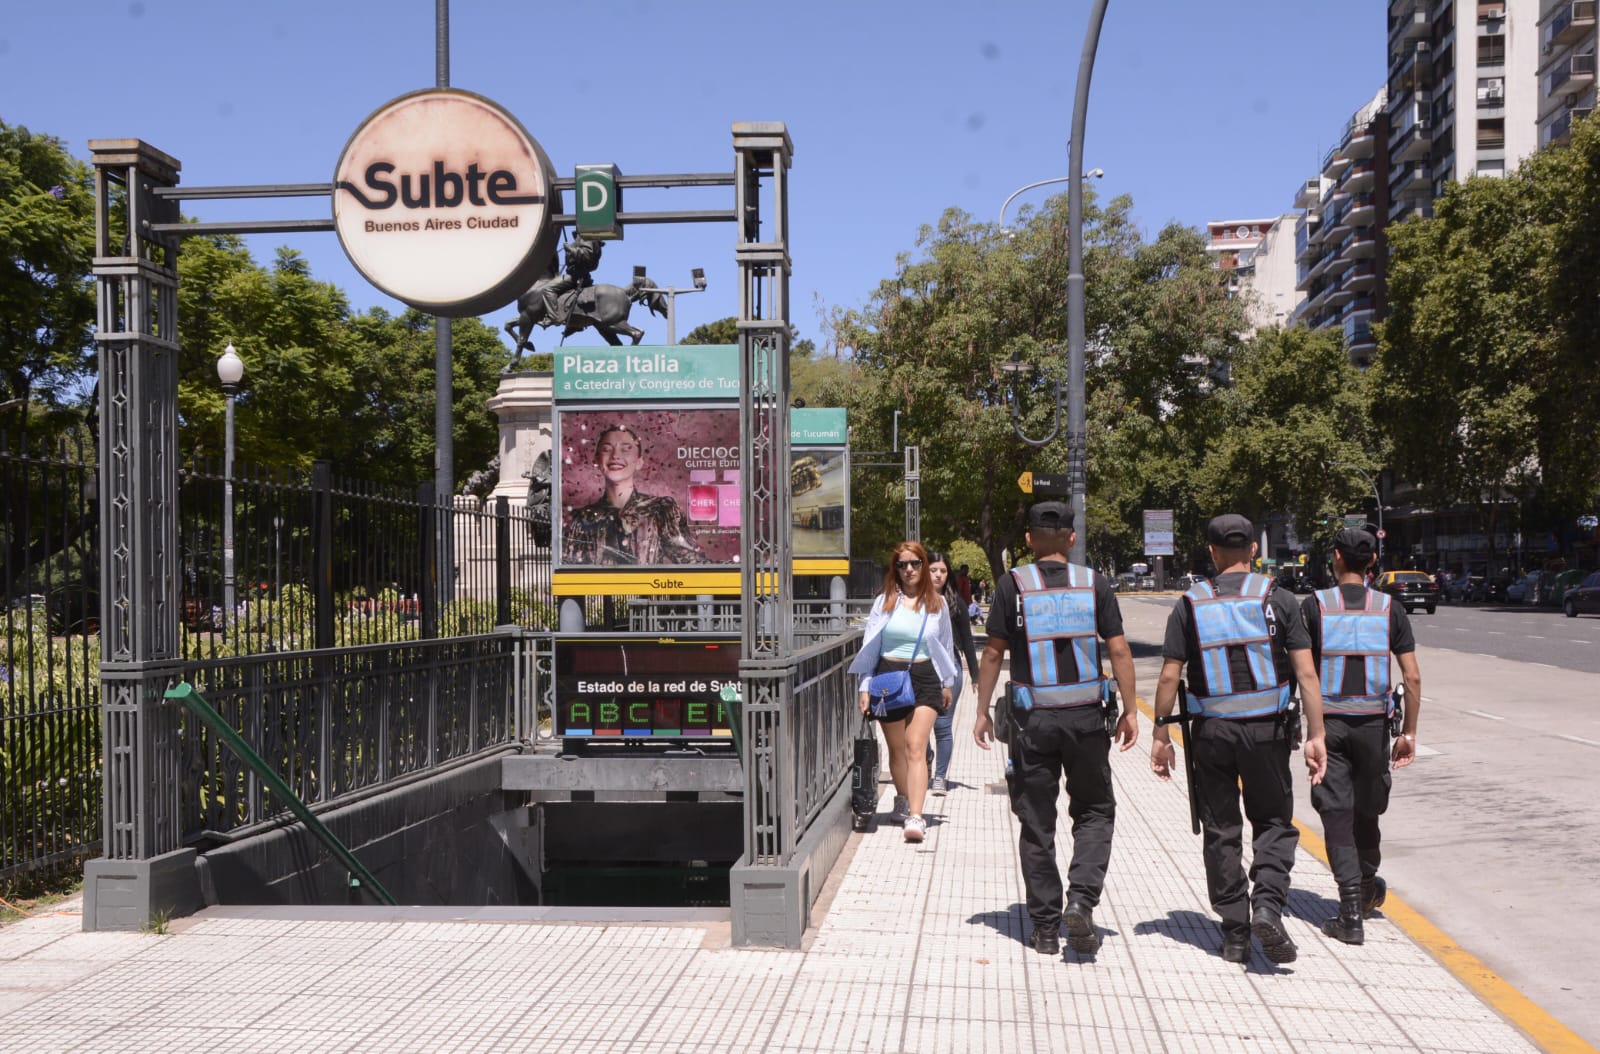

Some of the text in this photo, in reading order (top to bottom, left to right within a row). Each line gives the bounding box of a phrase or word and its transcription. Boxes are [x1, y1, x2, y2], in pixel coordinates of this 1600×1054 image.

[356, 161, 540, 209] Subte
[582, 181, 608, 212] D
[364, 216, 519, 233] Buenos Aires Ciudad
[563, 354, 679, 374] Plaza Italia
[564, 382, 571, 390] a
[574, 379, 625, 390] Catedral
[629, 381, 637, 392] y
[639, 378, 695, 392] Congreso
[698, 378, 714, 388] de
[677, 447, 740, 460] DIECIOC
[685, 460, 740, 468] GLITTER EDITI
[651, 578, 684, 589] Subte
[577, 681, 624, 693] Estado
[627, 681, 645, 693] de
[649, 681, 660, 693] la
[664, 680, 686, 692] red
[689, 680, 707, 692] de
[571, 703, 590, 722] A
[600, 703, 619, 722] B
[629, 703, 648, 722] C
[688, 703, 707, 722] E
